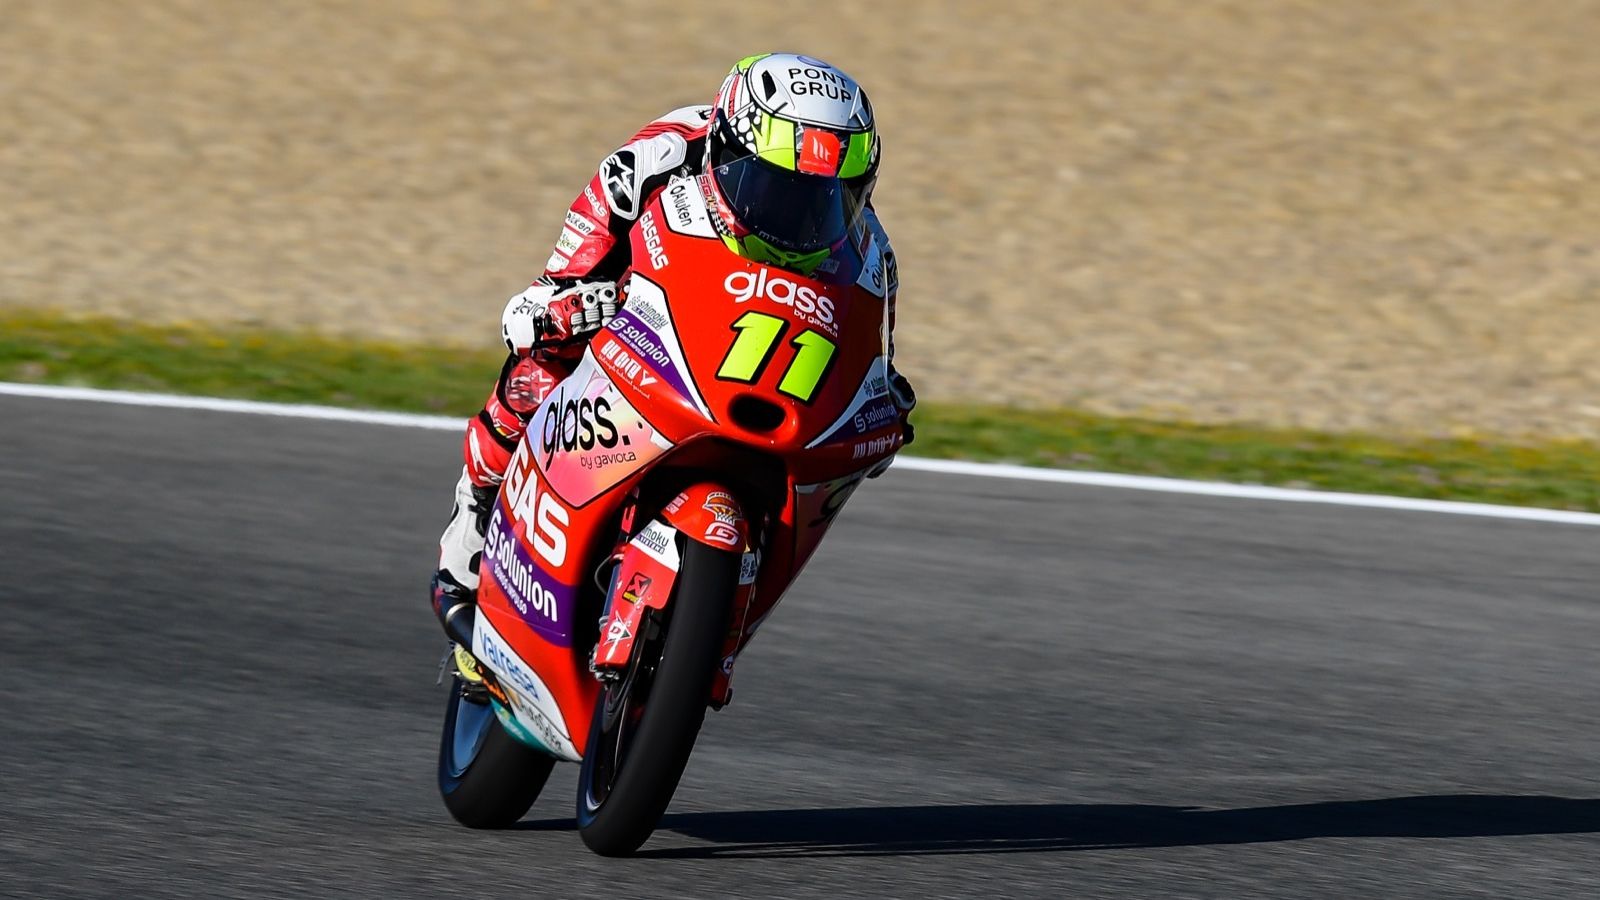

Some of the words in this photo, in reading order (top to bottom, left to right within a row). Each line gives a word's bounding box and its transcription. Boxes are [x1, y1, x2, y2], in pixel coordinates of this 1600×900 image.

[788, 68, 847, 89] PONT
[790, 81, 852, 103] GRUP
[639, 211, 669, 270] GASGAS
[793, 309, 806, 320] by
[622, 325, 670, 367] solunion
[715, 311, 838, 403] 11
[580, 454, 593, 470] by
[594, 450, 637, 468] gaviota
[641, 527, 670, 547] moku
[497, 531, 558, 623] solunion
